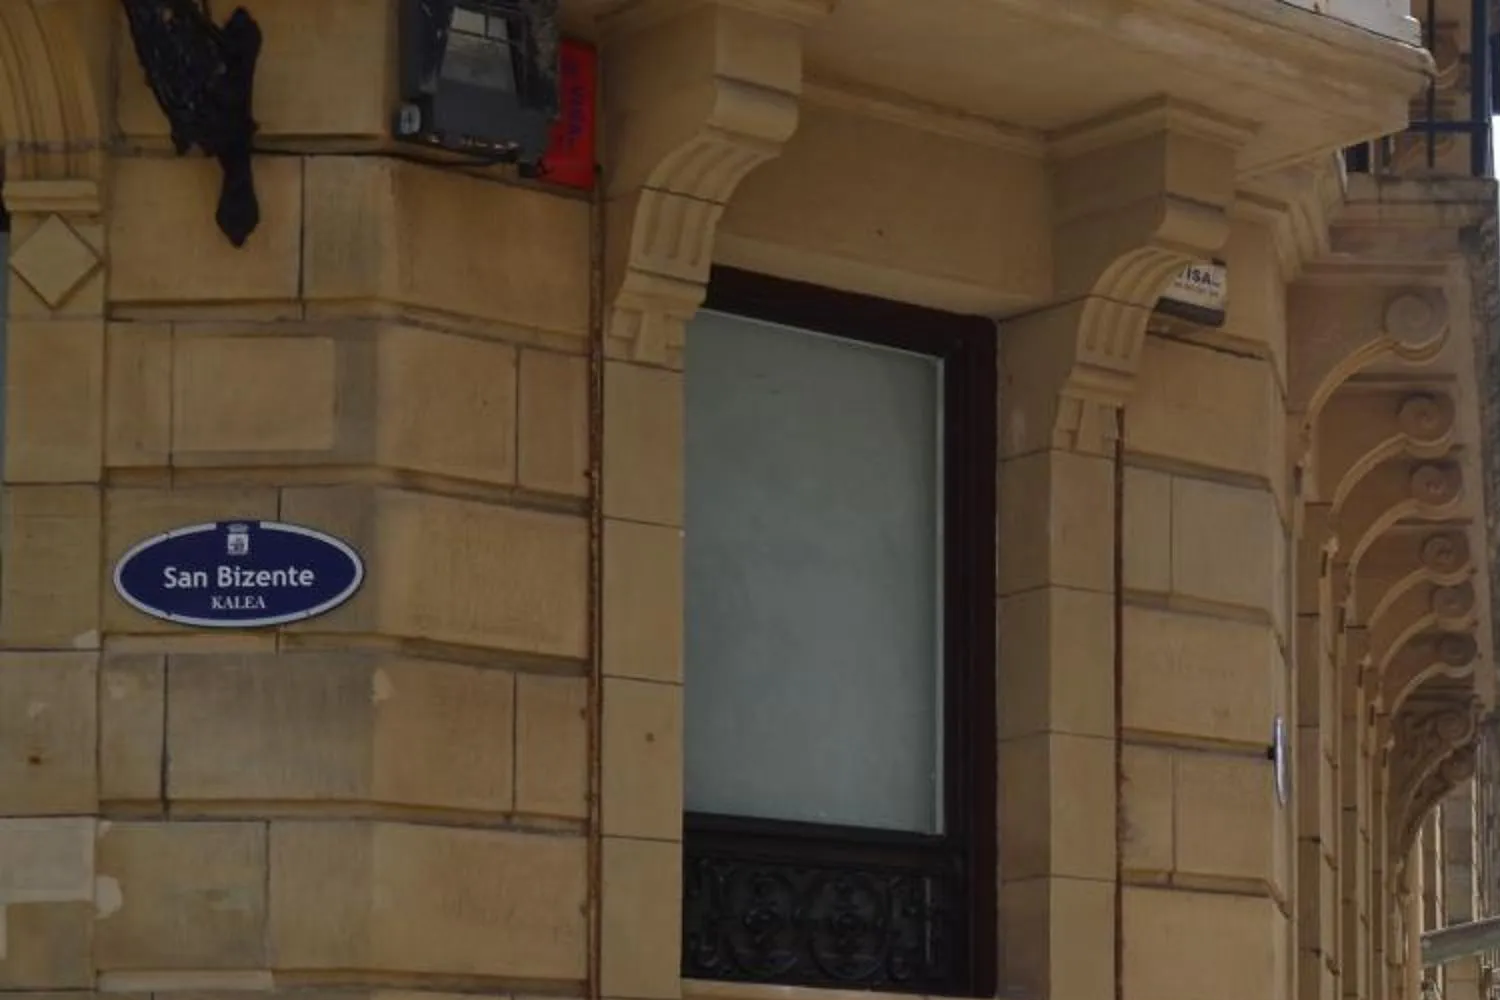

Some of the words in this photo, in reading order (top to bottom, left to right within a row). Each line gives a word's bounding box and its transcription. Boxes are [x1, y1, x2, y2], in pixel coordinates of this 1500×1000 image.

[163, 566, 208, 589] San
[217, 565, 315, 587] Bizente
[211, 596, 266, 610] KALEA
